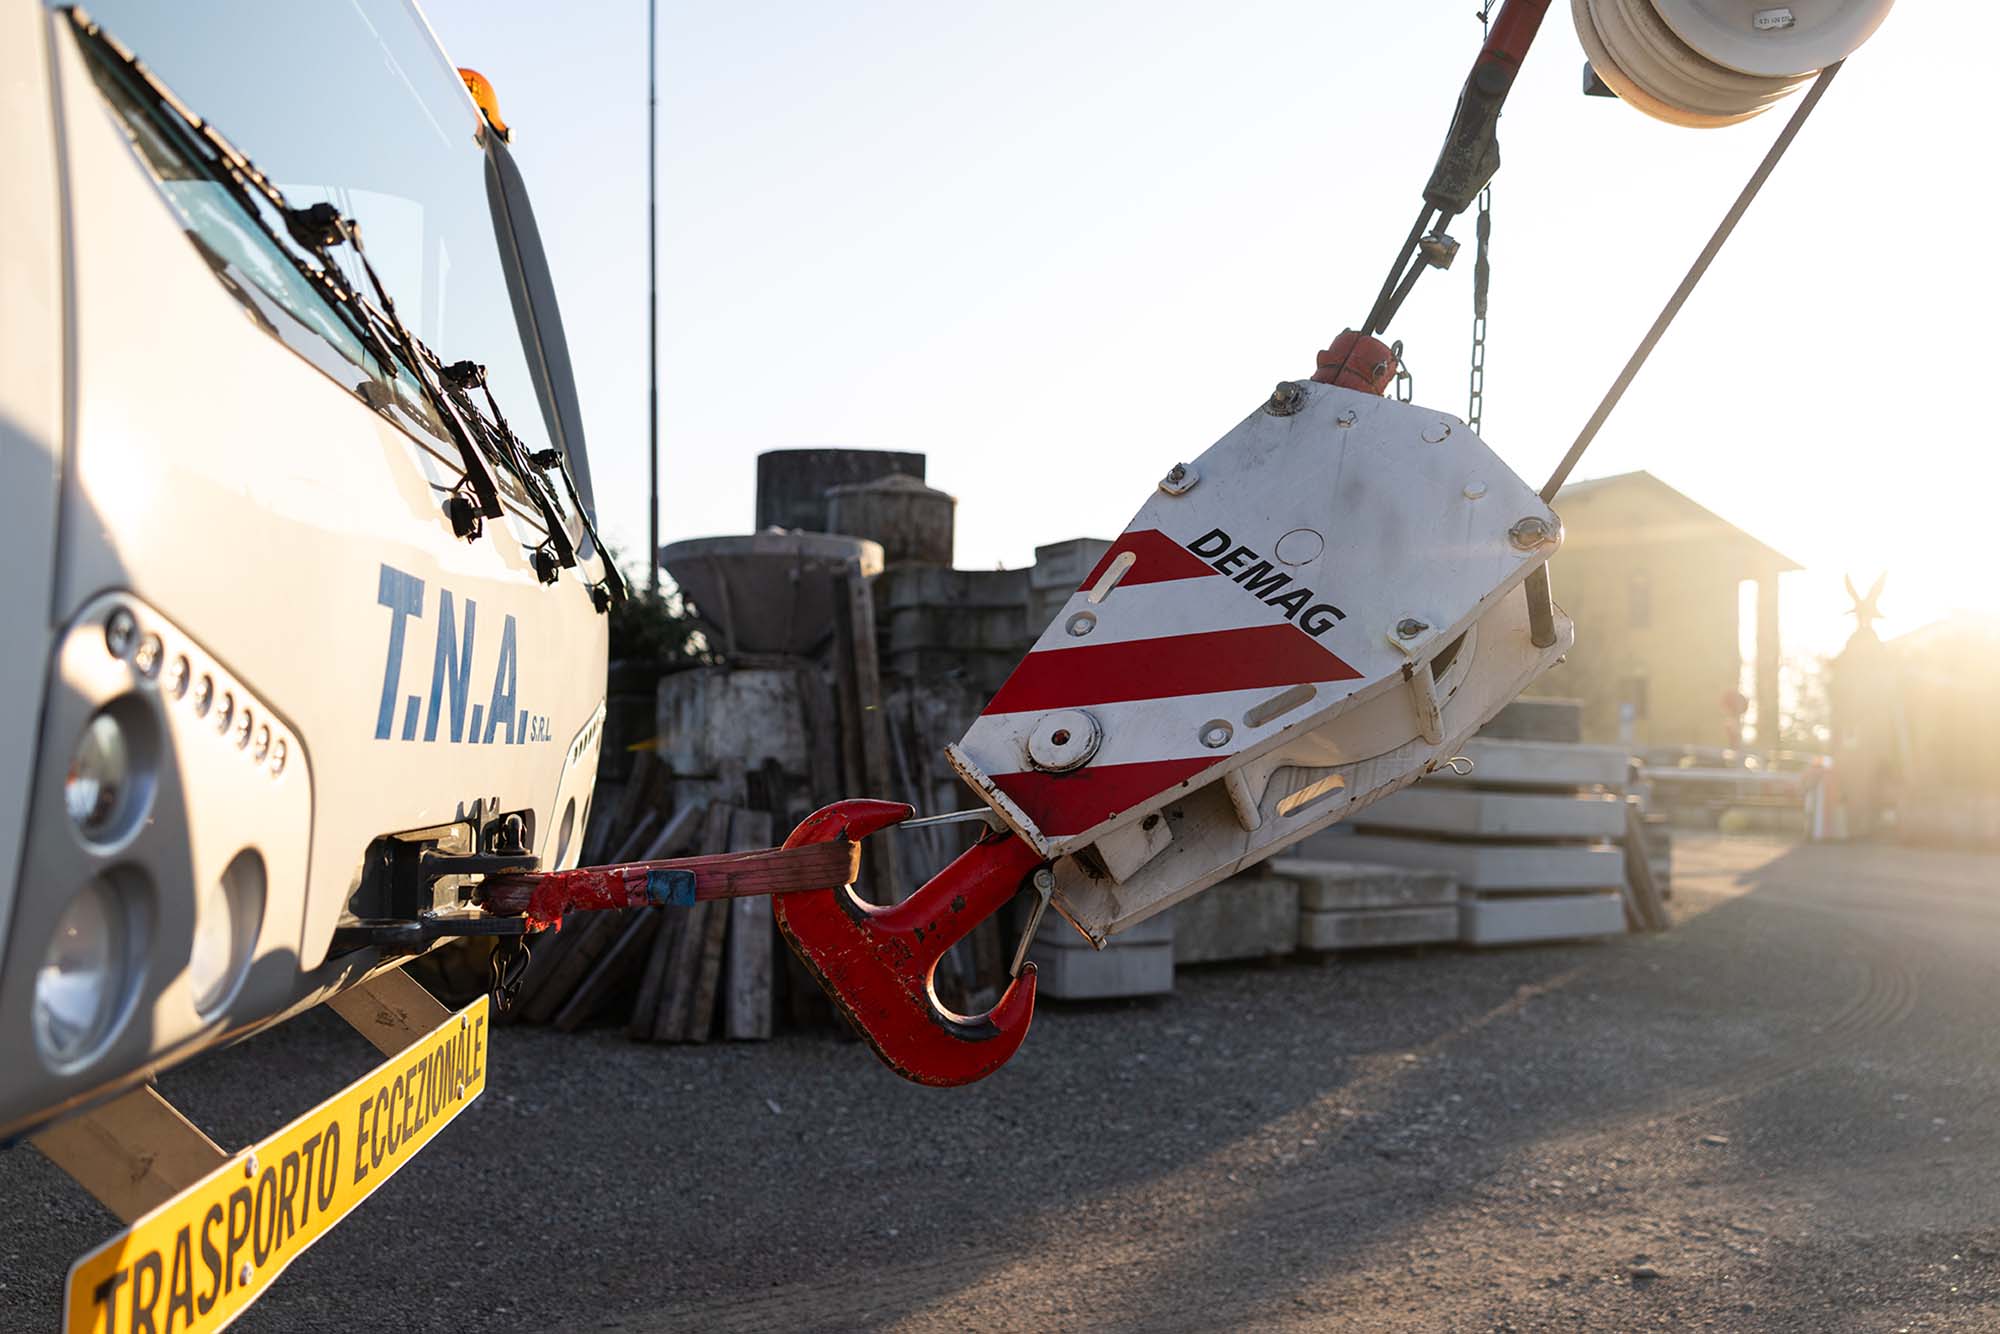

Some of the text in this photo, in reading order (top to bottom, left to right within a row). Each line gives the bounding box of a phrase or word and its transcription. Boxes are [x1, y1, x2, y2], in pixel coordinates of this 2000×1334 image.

[375, 563, 528, 744] T.N.A.
[1186, 528, 1347, 637] DEMAG
[93, 1015, 484, 1334] TRASPORTO ECCEZIONALE
